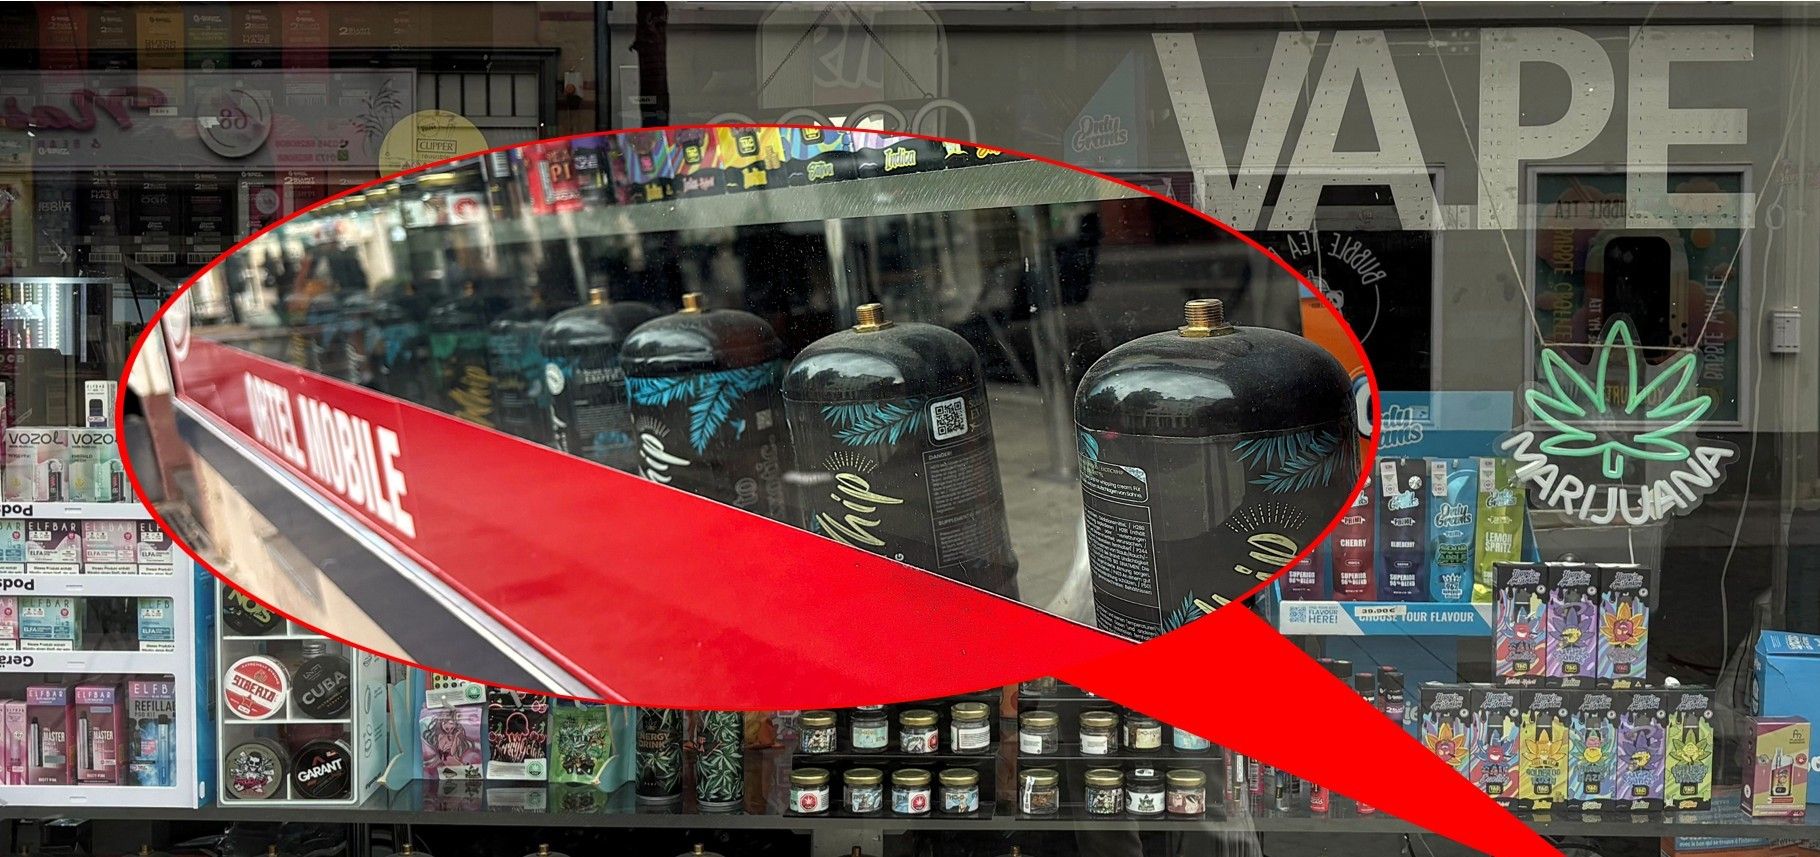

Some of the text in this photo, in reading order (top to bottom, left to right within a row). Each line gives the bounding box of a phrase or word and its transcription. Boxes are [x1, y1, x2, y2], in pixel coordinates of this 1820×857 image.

[1152, 26, 1756, 231] VAPE
[419, 141, 453, 151] CLIPPER
[884, 147, 917, 172] Indica
[72, 433, 117, 444] VOZO
[297, 394, 416, 539] MOBILE
[1501, 431, 1735, 525] MARIJUANA
[0, 503, 33, 517] Pod
[28, 522, 76, 531] ELFBAR
[85, 522, 136, 532] ELFBAR
[1340, 539, 1366, 547] CHERRY
[1485, 532, 1513, 543] LEMON
[1485, 542, 1513, 554] SPRITZ
[1308, 615, 1338, 624] HERE!
[1402, 612, 1428, 622] YOUR
[1430, 612, 1474, 622] FLAVOUR
[231, 674, 277, 704] SIBERIA
[302, 670, 347, 705] CUBA
[77, 691, 111, 699] ELFBAR
[44, 731, 65, 742] MASTER
[93, 731, 114, 740] MASTER
[639, 732, 670, 741] NERGY
[639, 740, 665, 748] DRINK
[296, 757, 343, 783] GARANT
